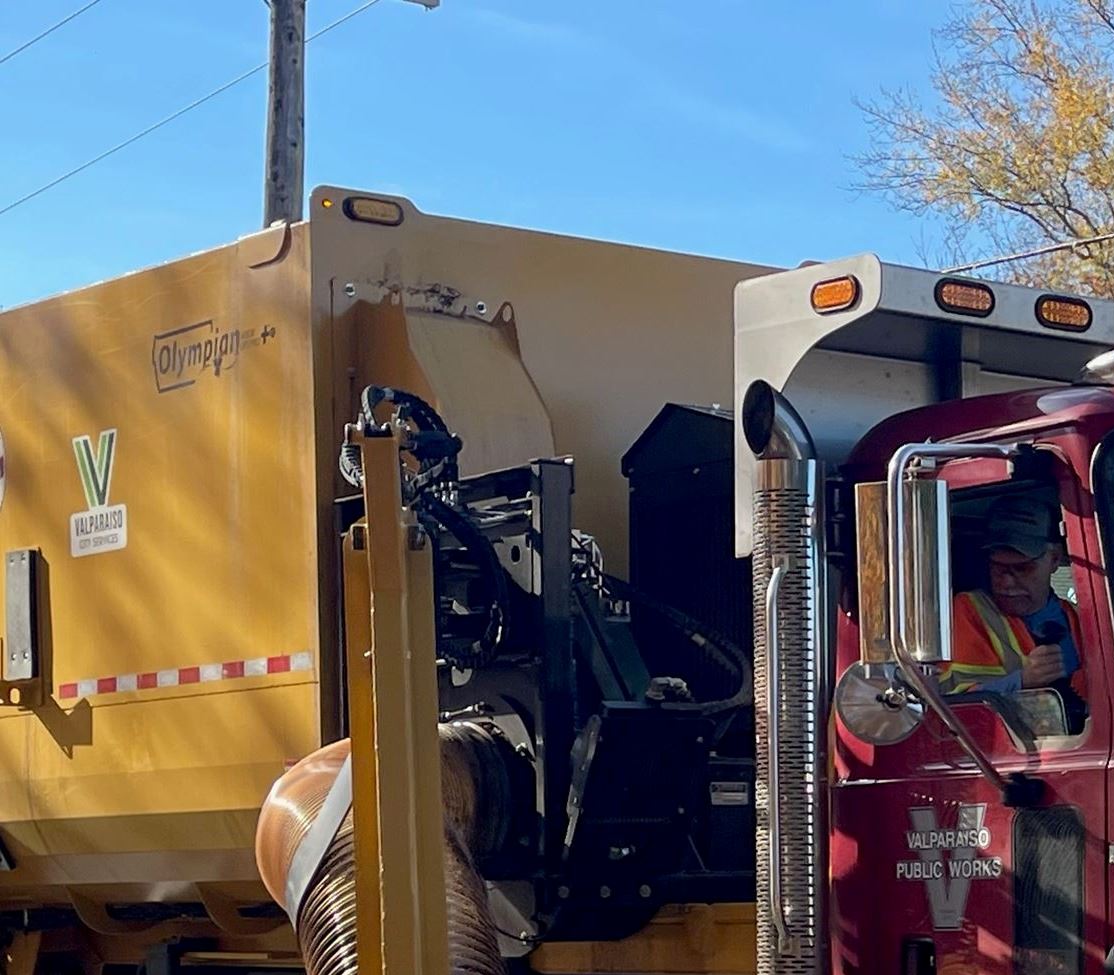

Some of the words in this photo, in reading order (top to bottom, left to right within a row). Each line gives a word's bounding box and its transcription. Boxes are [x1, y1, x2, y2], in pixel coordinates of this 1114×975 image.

[159, 327, 241, 376] Olympian
[74, 509, 123, 537] VALPARAISO
[906, 827, 990, 850] VALPARAISO
[896, 859, 943, 879] PUBLIC
[949, 857, 1002, 878] WORKS
